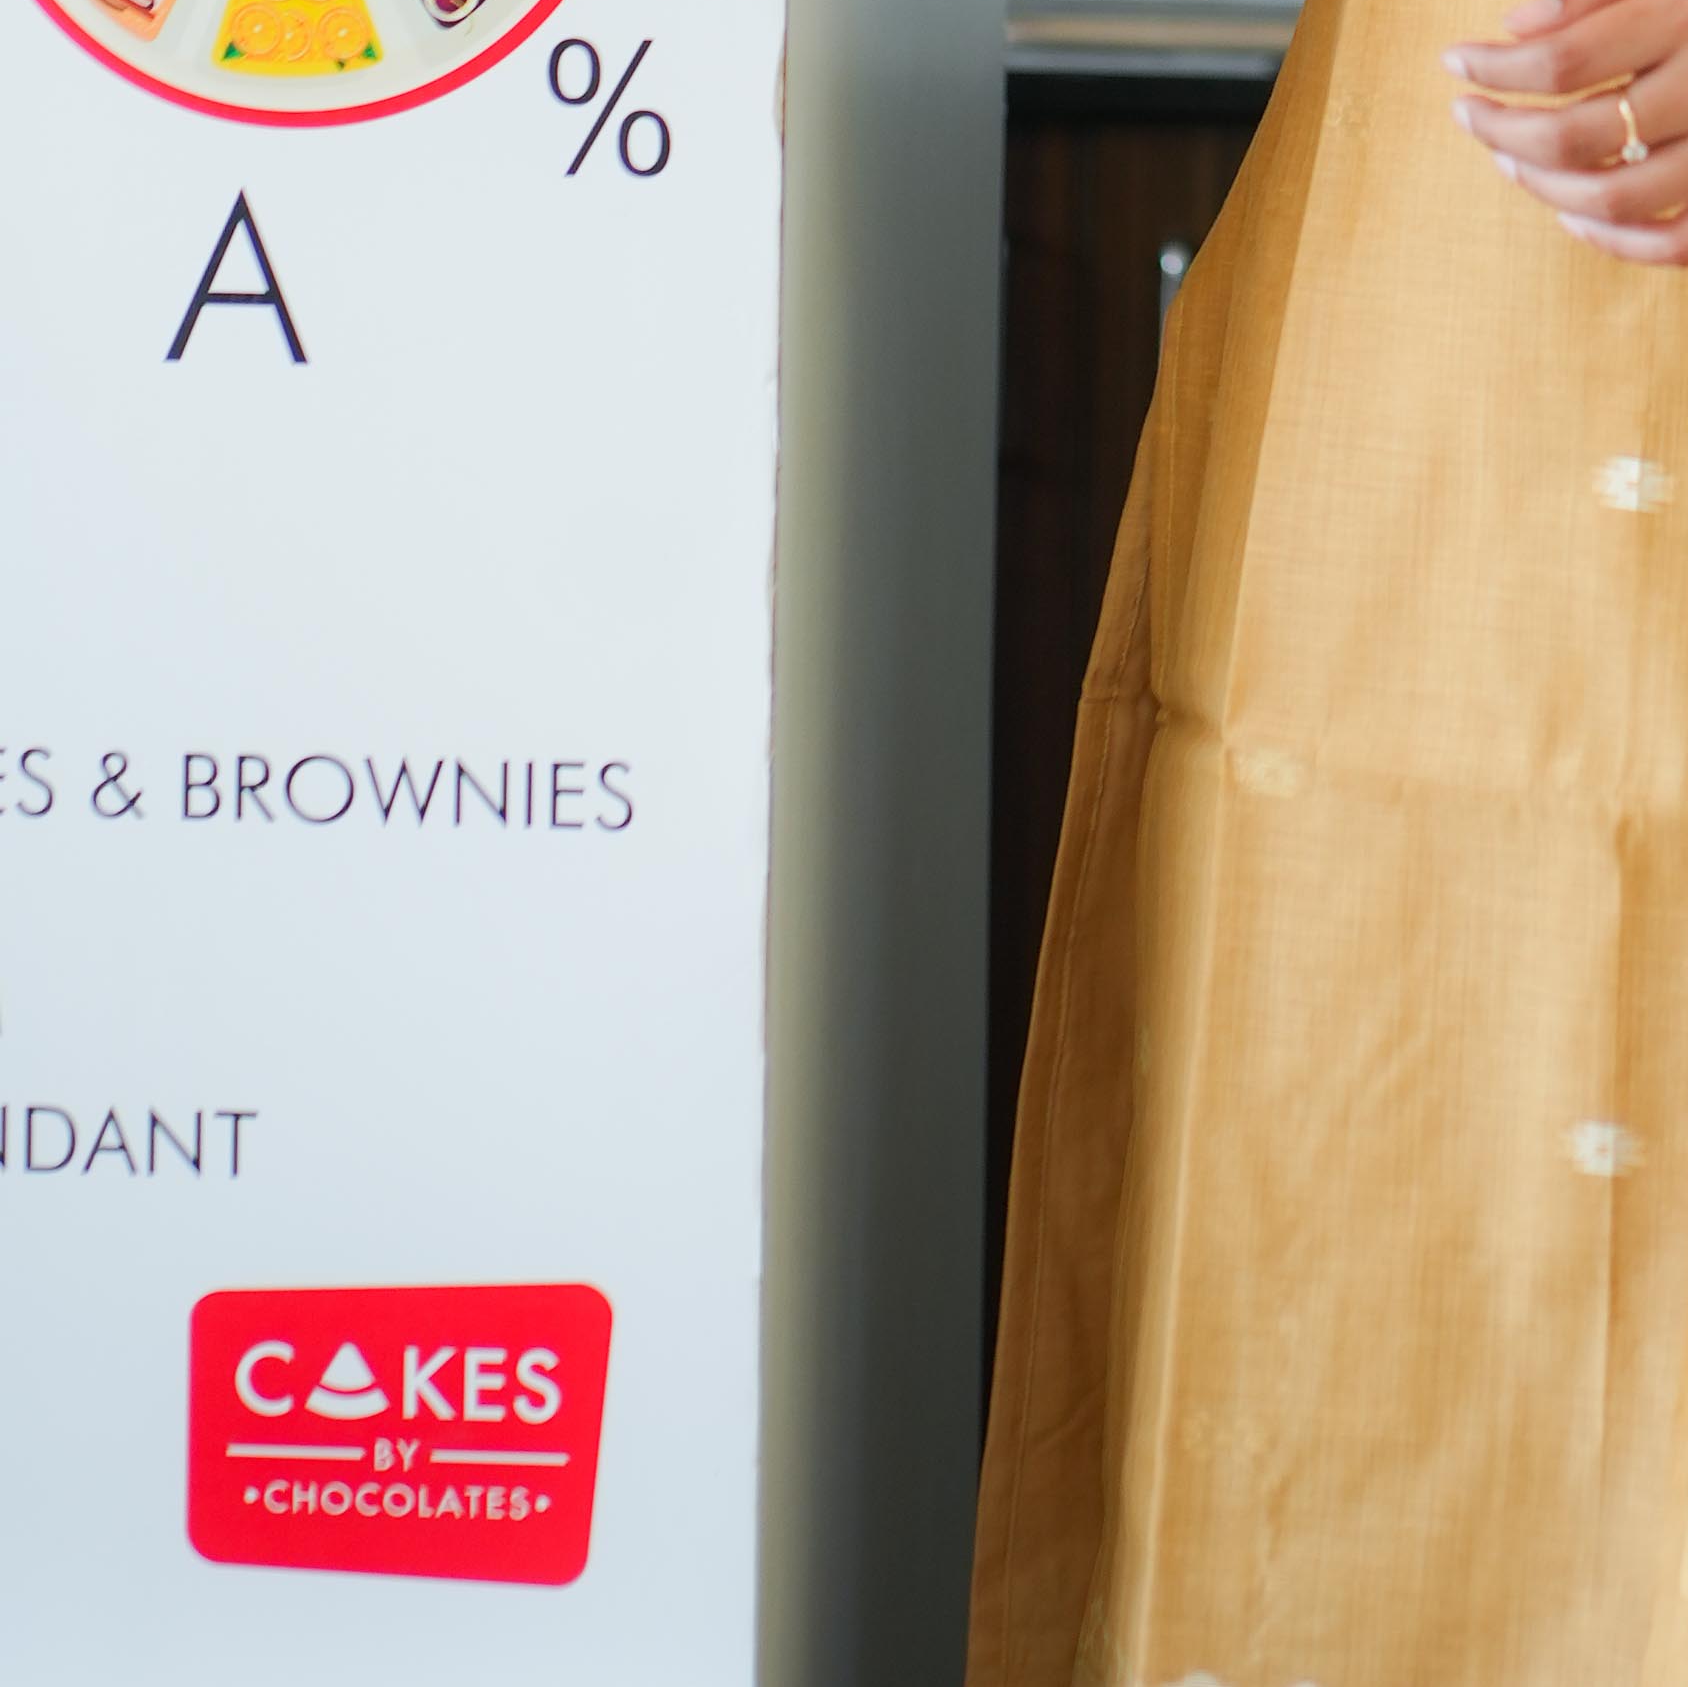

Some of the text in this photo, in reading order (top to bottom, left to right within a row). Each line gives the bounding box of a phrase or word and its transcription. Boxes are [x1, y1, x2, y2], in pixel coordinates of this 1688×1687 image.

[547, 37, 673, 178] %
[163, 187, 308, 364] A
[91, 751, 145, 820] &
[182, 752, 634, 832] BROWNIES
[373, 1437, 420, 1472] BY
